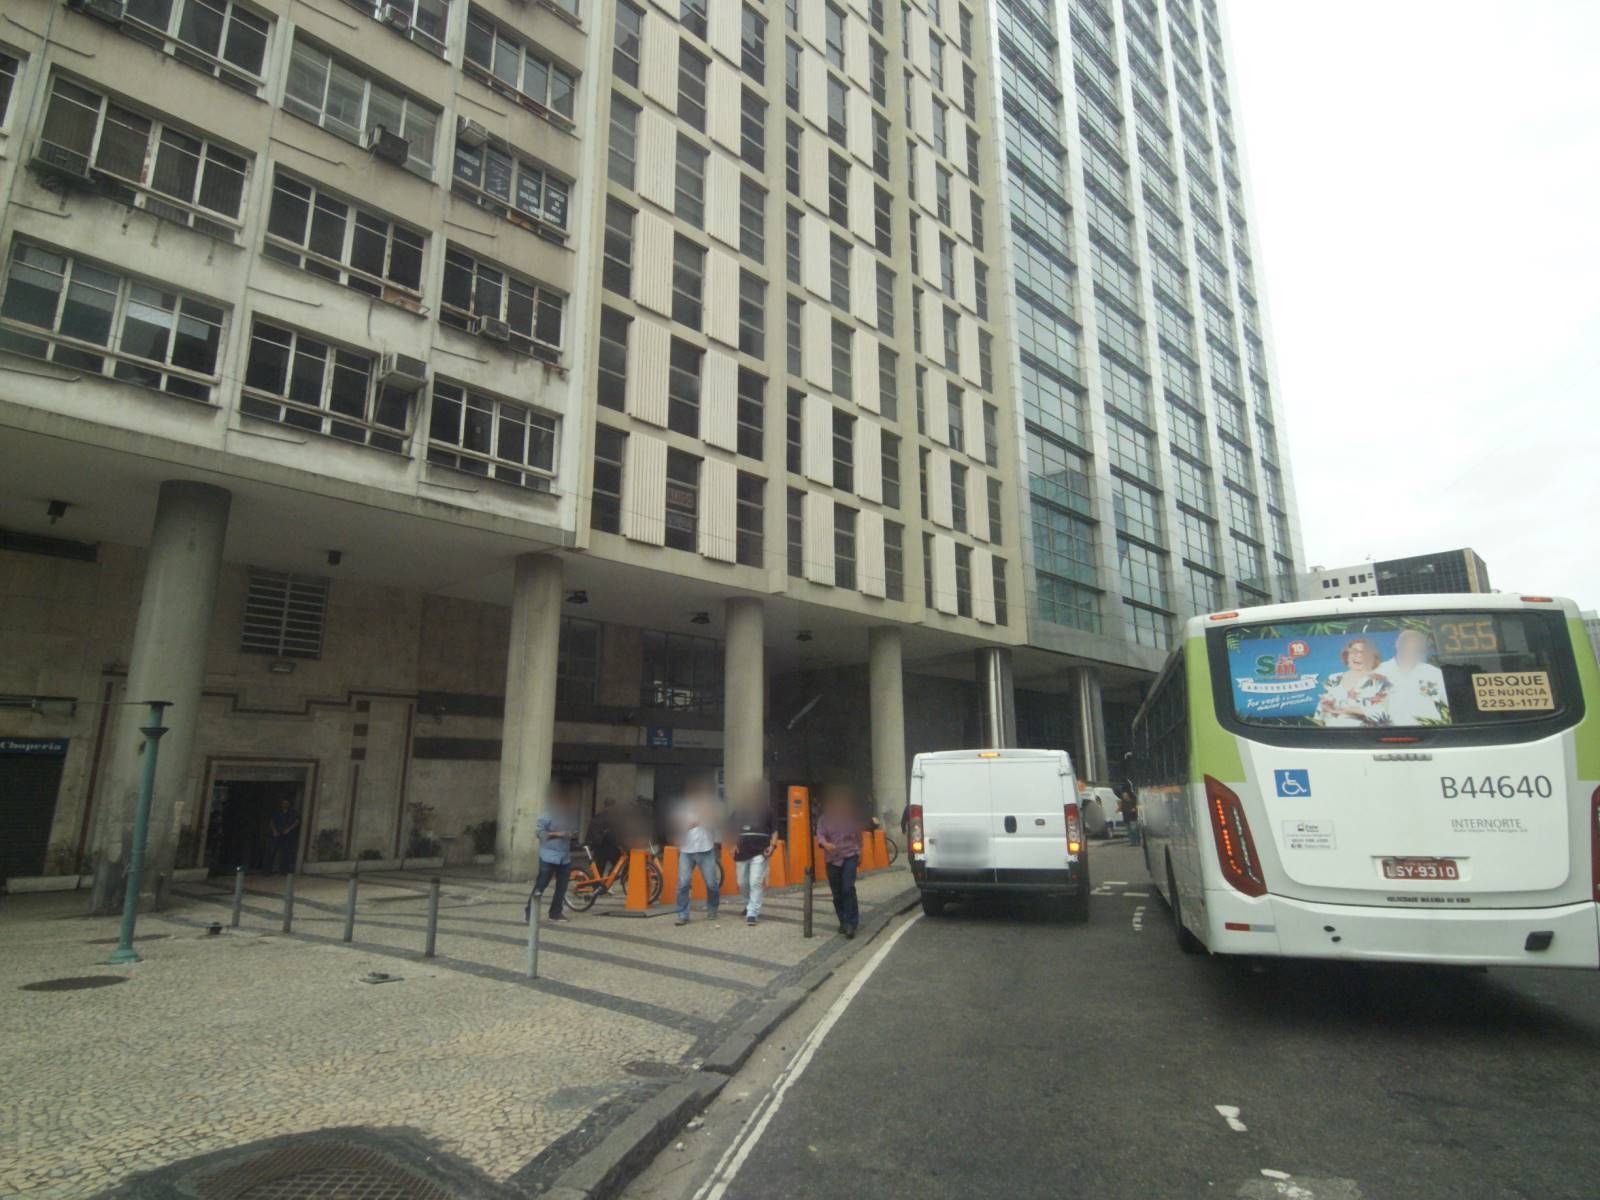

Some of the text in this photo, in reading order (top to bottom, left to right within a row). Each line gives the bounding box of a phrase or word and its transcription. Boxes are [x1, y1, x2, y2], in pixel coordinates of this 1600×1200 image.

[1440, 622, 1498, 651] 355
[1476, 675, 1545, 687] DISQUE
[1481, 698, 1549, 708] 2253-1177
[1440, 775, 1553, 799] B44640
[1451, 818, 1521, 829] INTERNORTE
